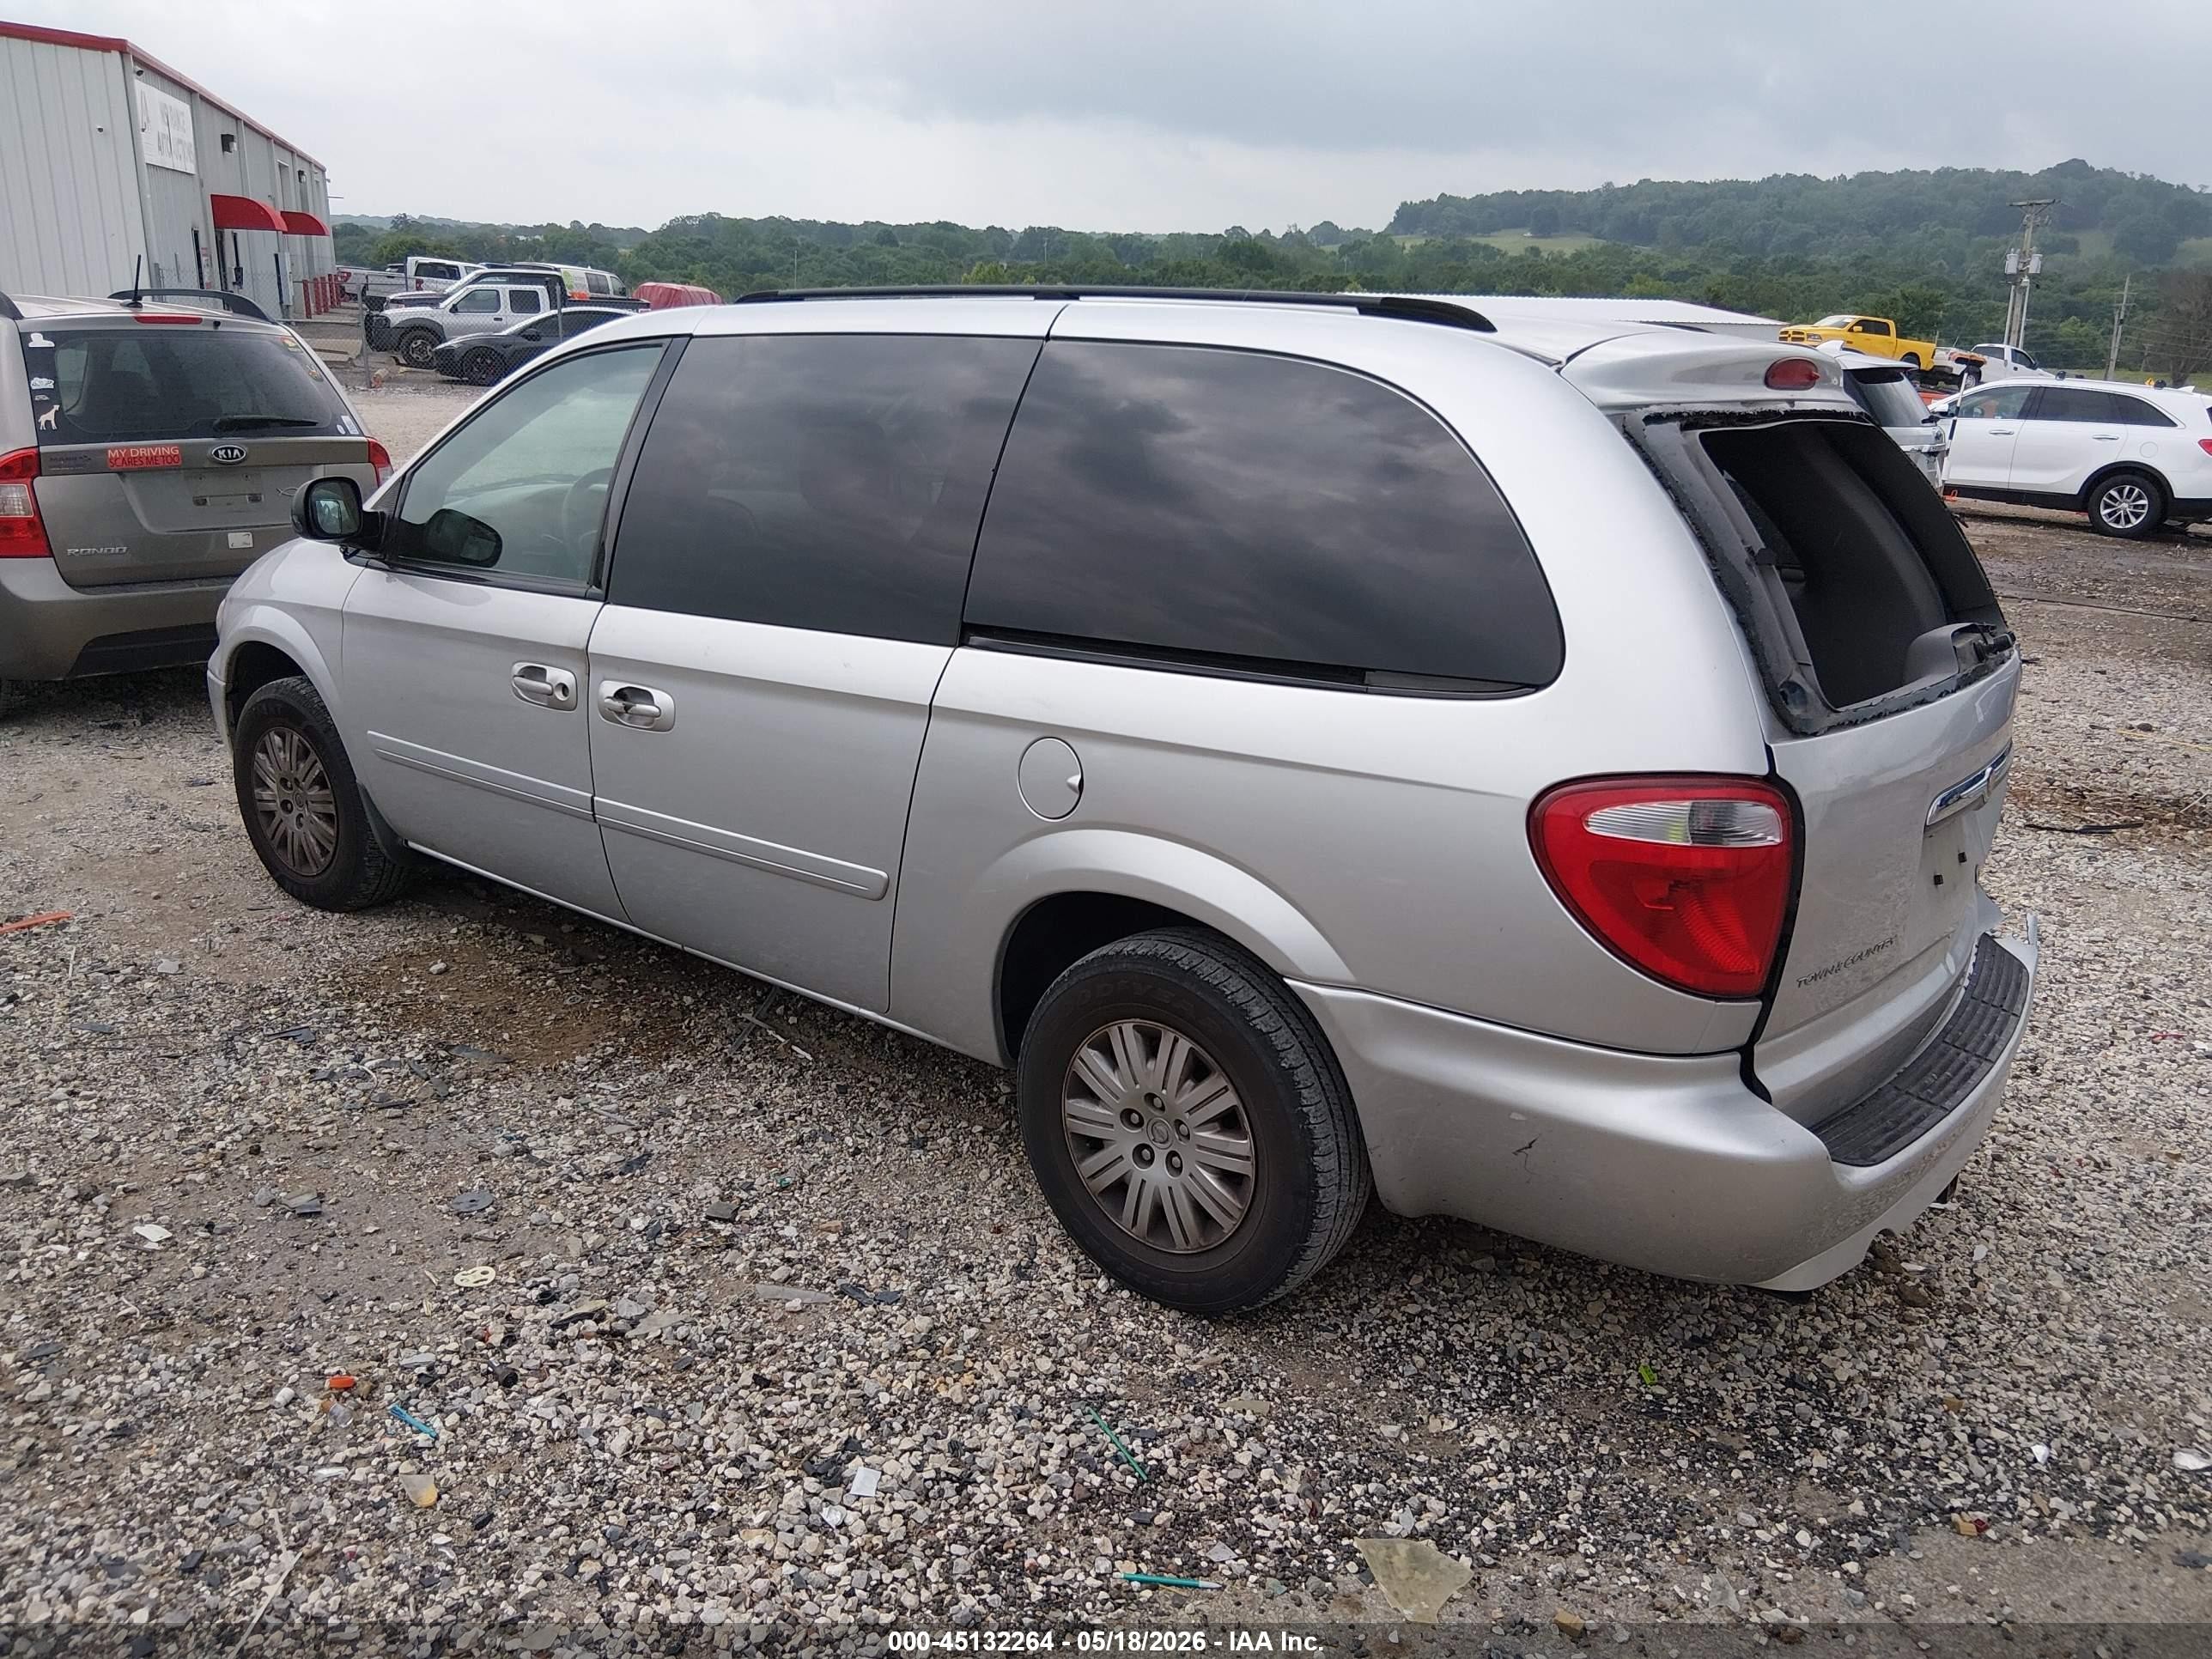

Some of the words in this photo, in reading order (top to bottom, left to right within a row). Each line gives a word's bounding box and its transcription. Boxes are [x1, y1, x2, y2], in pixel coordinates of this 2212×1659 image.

[108, 448, 127, 459] MY
[130, 446, 179, 458] DRIVING
[217, 448, 241, 459] KIA
[109, 455, 144, 467] SCARES
[146, 455, 159, 465] ME
[159, 453, 179, 465] TOO
[66, 546, 129, 557] RONDO
